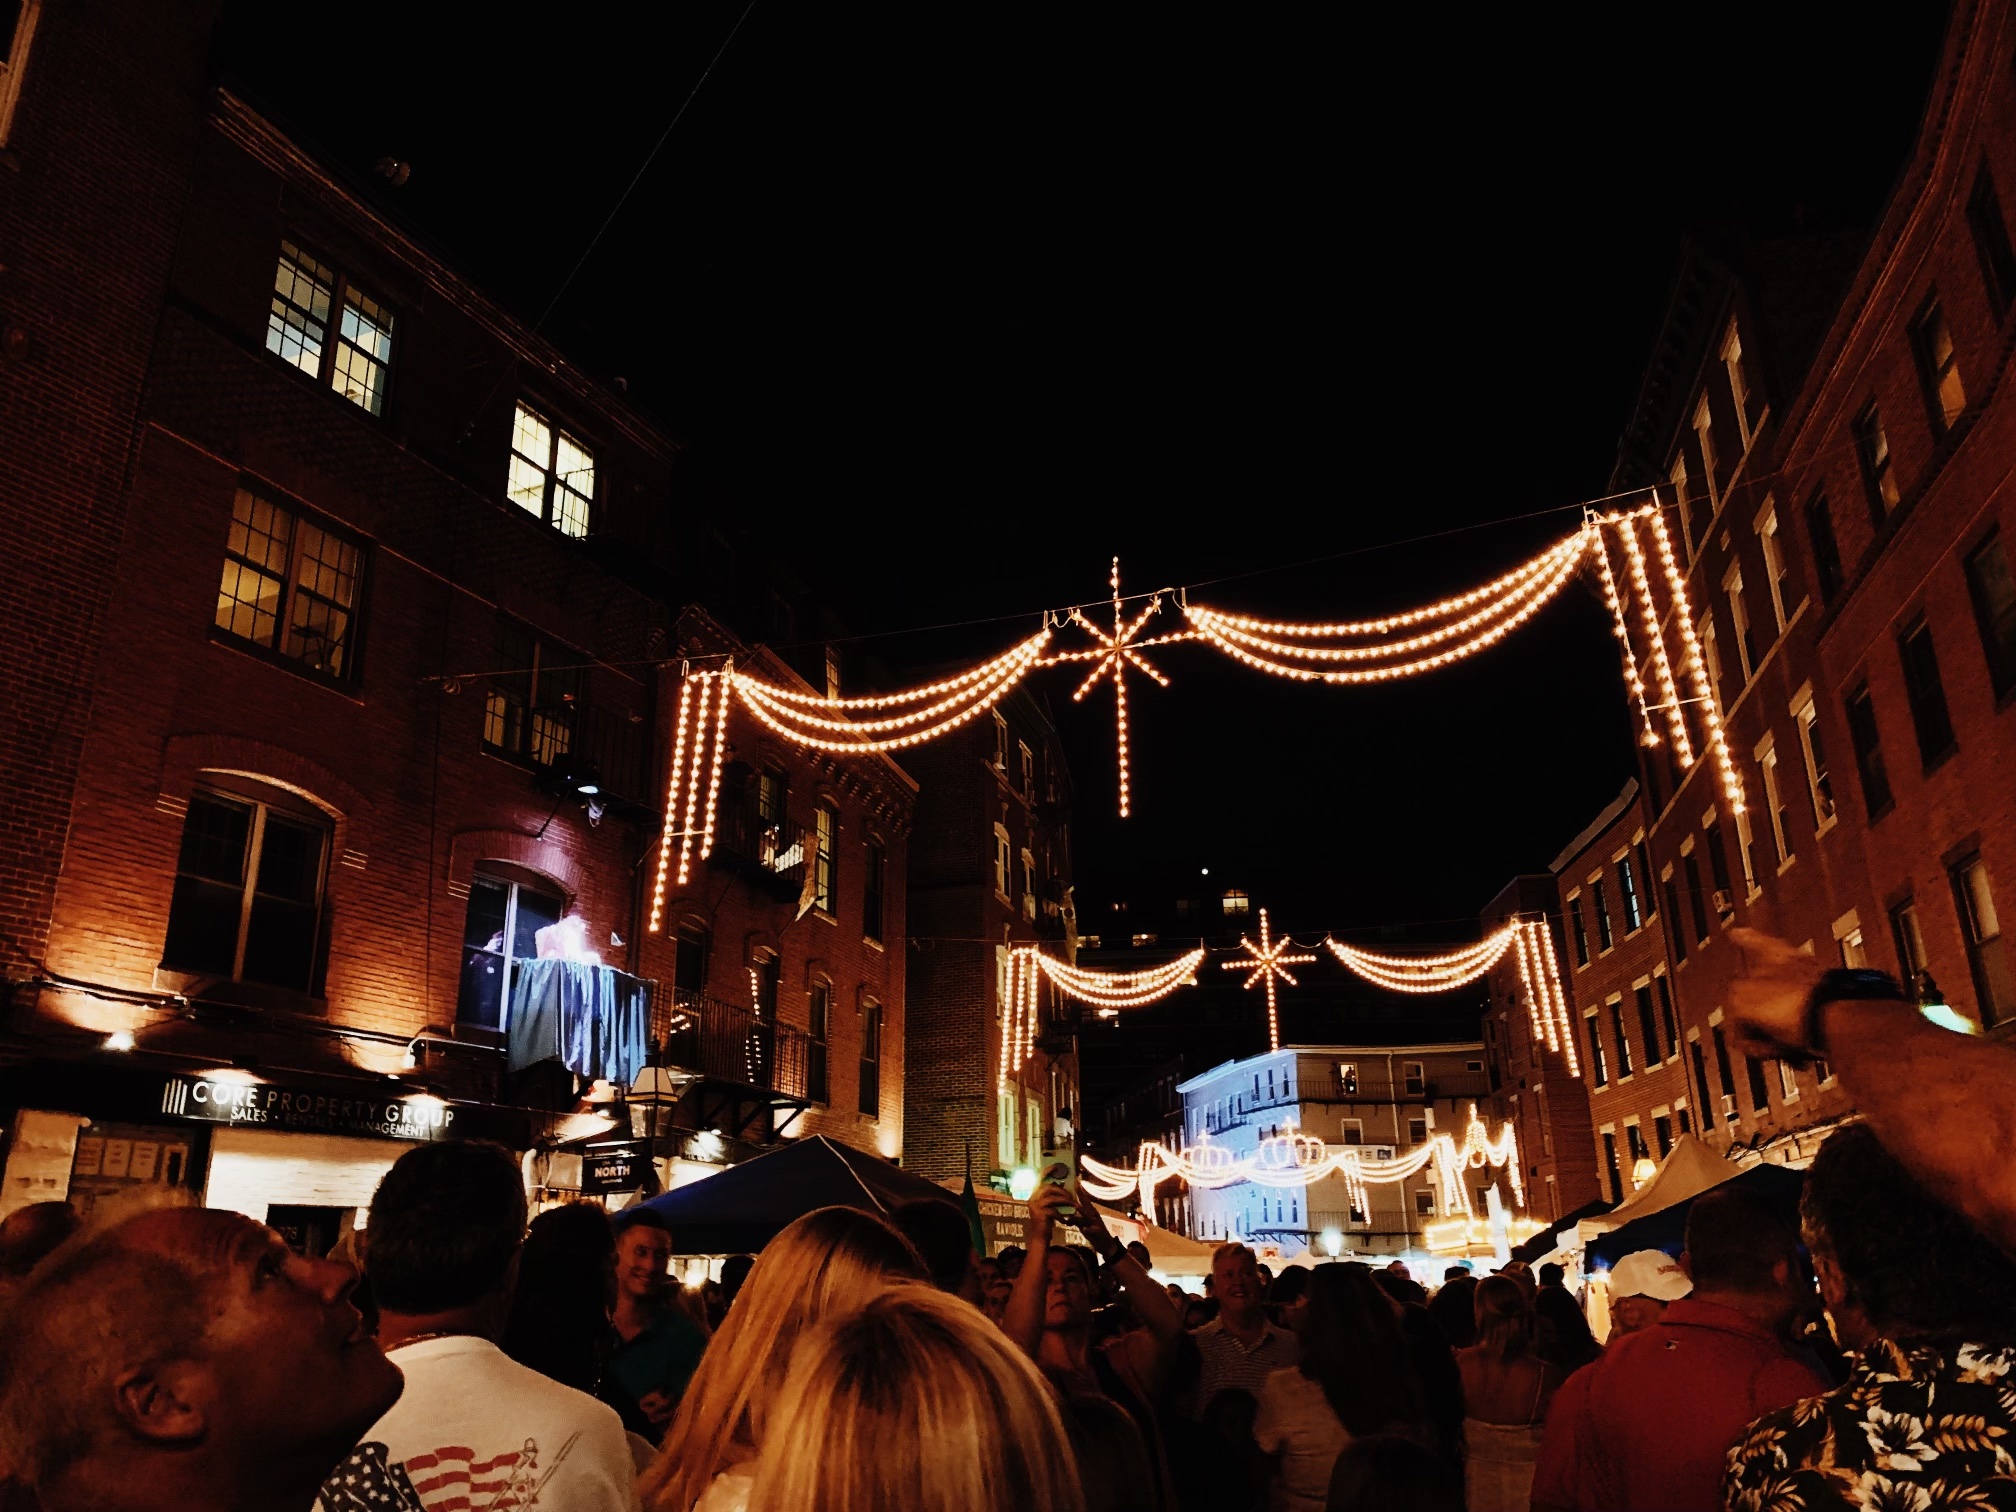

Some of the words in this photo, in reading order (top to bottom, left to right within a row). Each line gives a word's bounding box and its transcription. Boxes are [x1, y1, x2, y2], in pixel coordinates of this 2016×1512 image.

[192, 1081, 259, 1108] CORE
[266, 1090, 378, 1120] PROPERTY
[385, 1103, 455, 1128] GROUP
[230, 1105, 268, 1122] SALES
[349, 1119, 426, 1137] MANAGEMENT
[594, 1164, 631, 1178] NORTH
[978, 1201, 1002, 1217] CHICKEN
[996, 1222, 1024, 1237] RAVIOLIS
